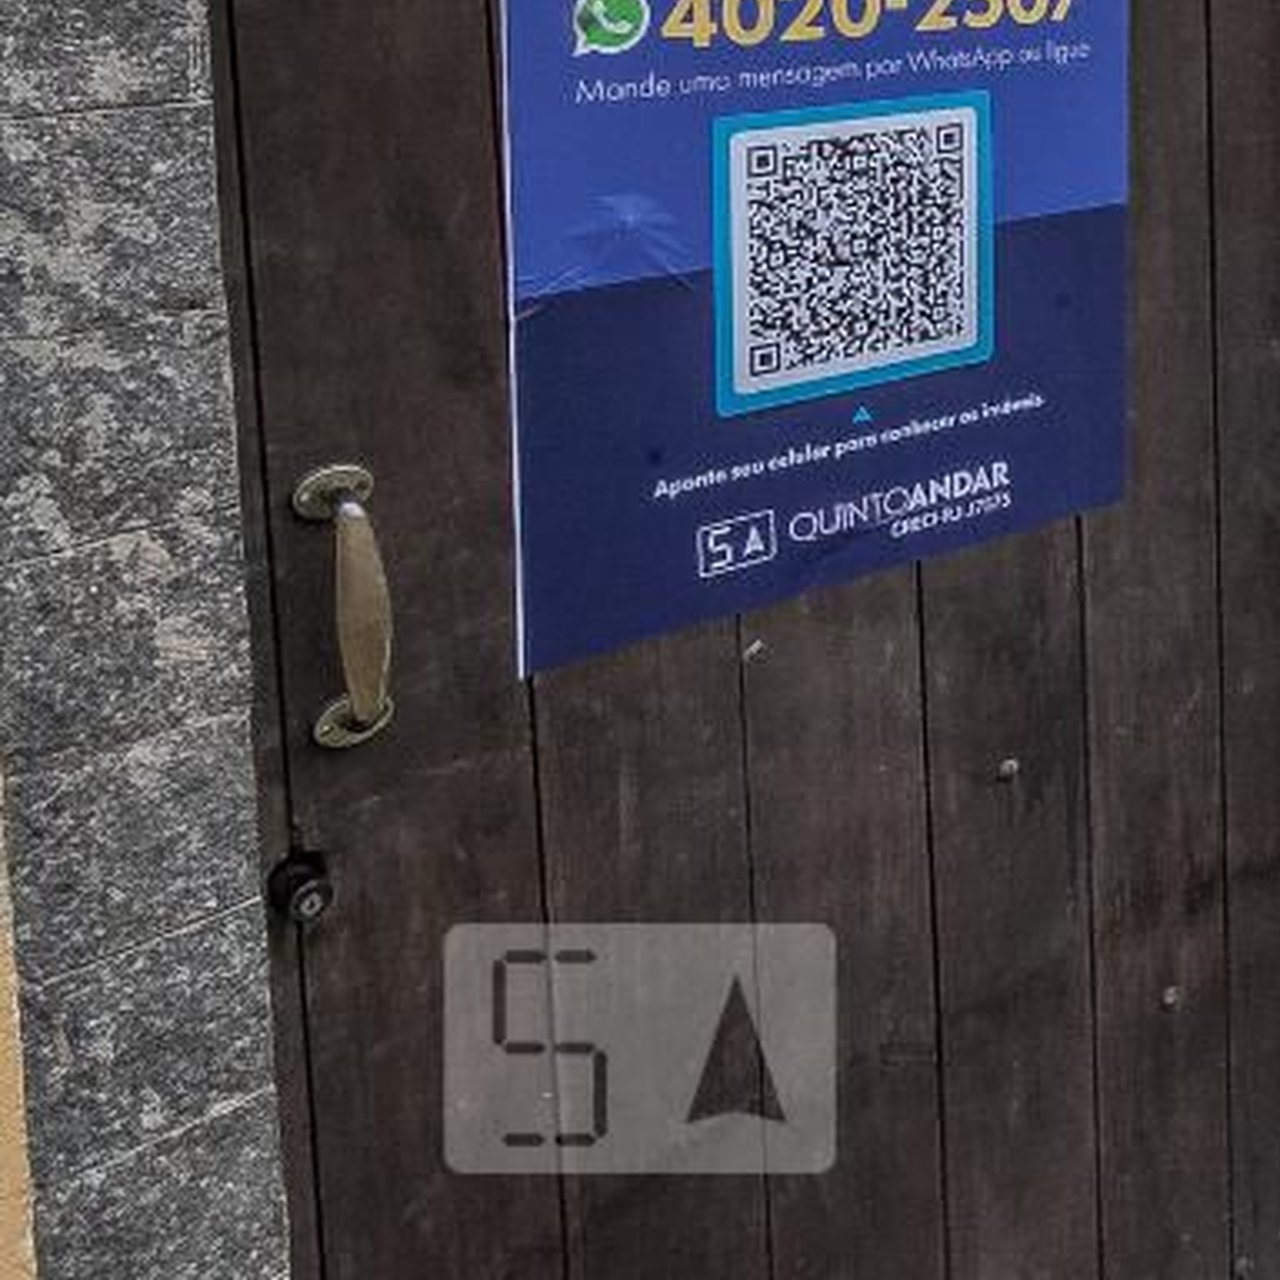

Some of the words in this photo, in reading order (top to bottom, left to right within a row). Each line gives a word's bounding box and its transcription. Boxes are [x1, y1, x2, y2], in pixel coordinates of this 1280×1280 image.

[575, 70, 671, 104] Mande
[679, 74, 731, 94] uma
[738, 61, 859, 88] mensagem
[865, 57, 903, 81] por
[906, 46, 1014, 72] WhatsApp
[1045, 38, 1092, 65] ligue
[653, 470, 728, 500] Aponte
[730, 460, 765, 481] seu
[766, 442, 832, 470] celular
[834, 433, 878, 460] para
